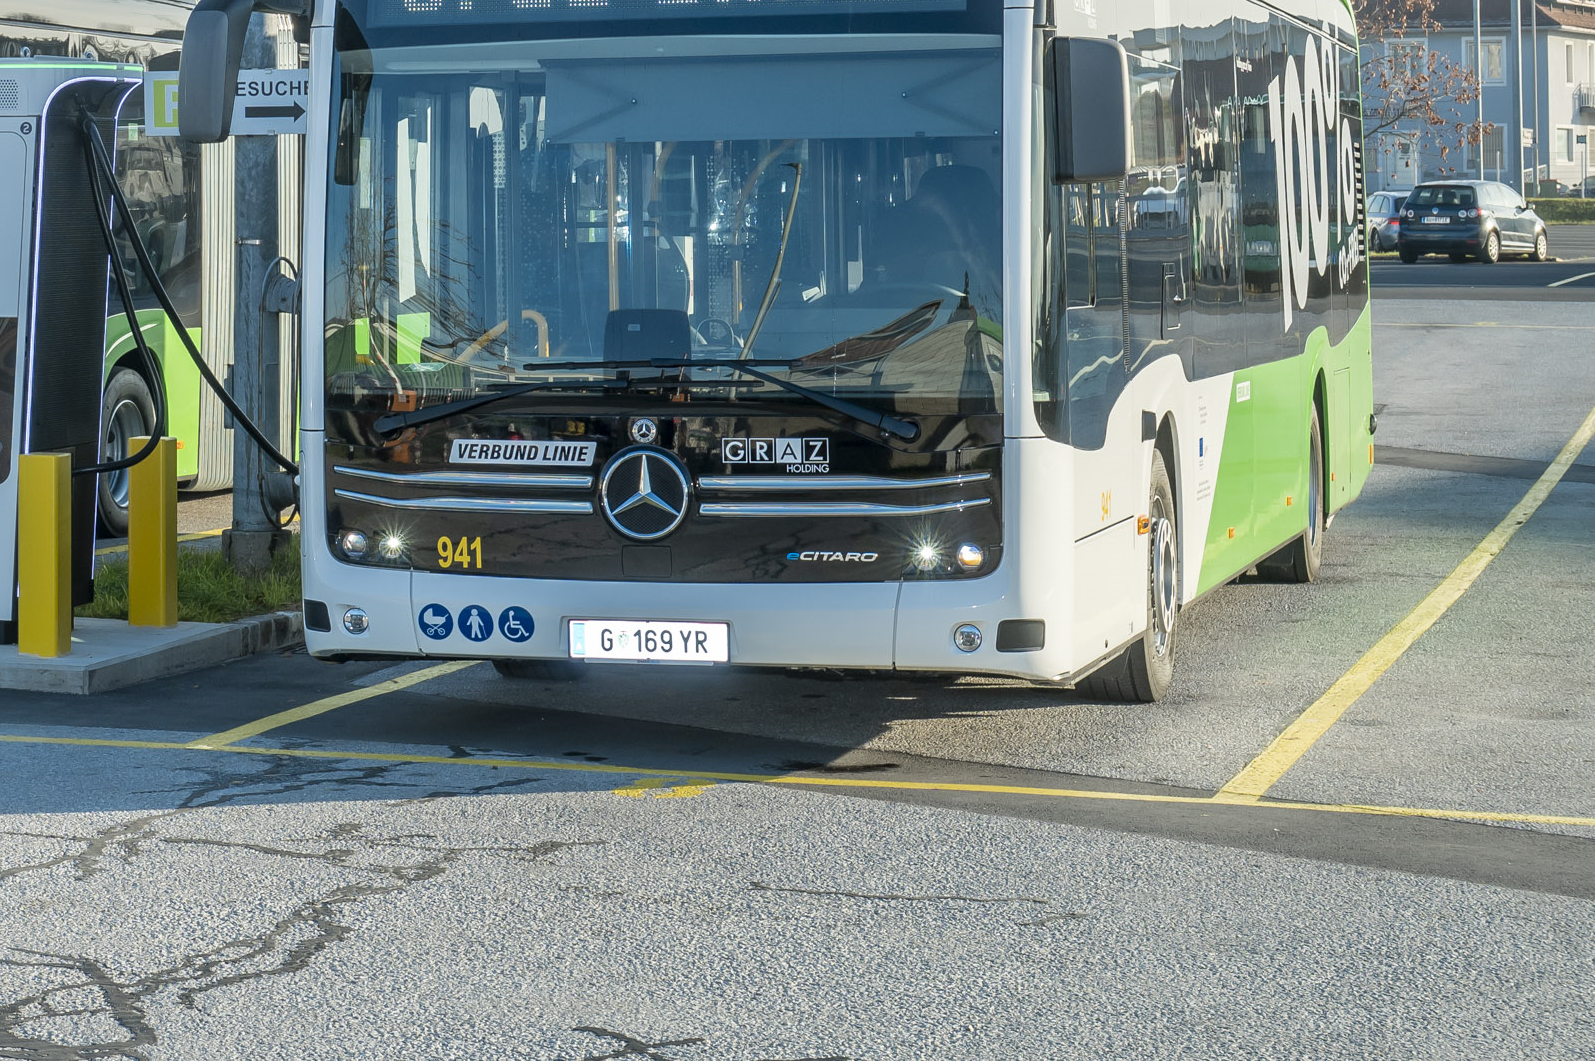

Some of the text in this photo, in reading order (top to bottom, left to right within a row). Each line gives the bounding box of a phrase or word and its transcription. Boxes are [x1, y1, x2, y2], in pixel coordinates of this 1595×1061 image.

[1268, 9, 1355, 332] 100%
[458, 443, 589, 462] VERBUND LINIE
[722, 438, 829, 463] GRAZ
[786, 464, 830, 473] HOLDING
[437, 536, 482, 568] 941
[786, 551, 879, 562] eCITARO
[600, 628, 613, 652] G
[633, 629, 673, 653] 169
[680, 630, 708, 654] YR
